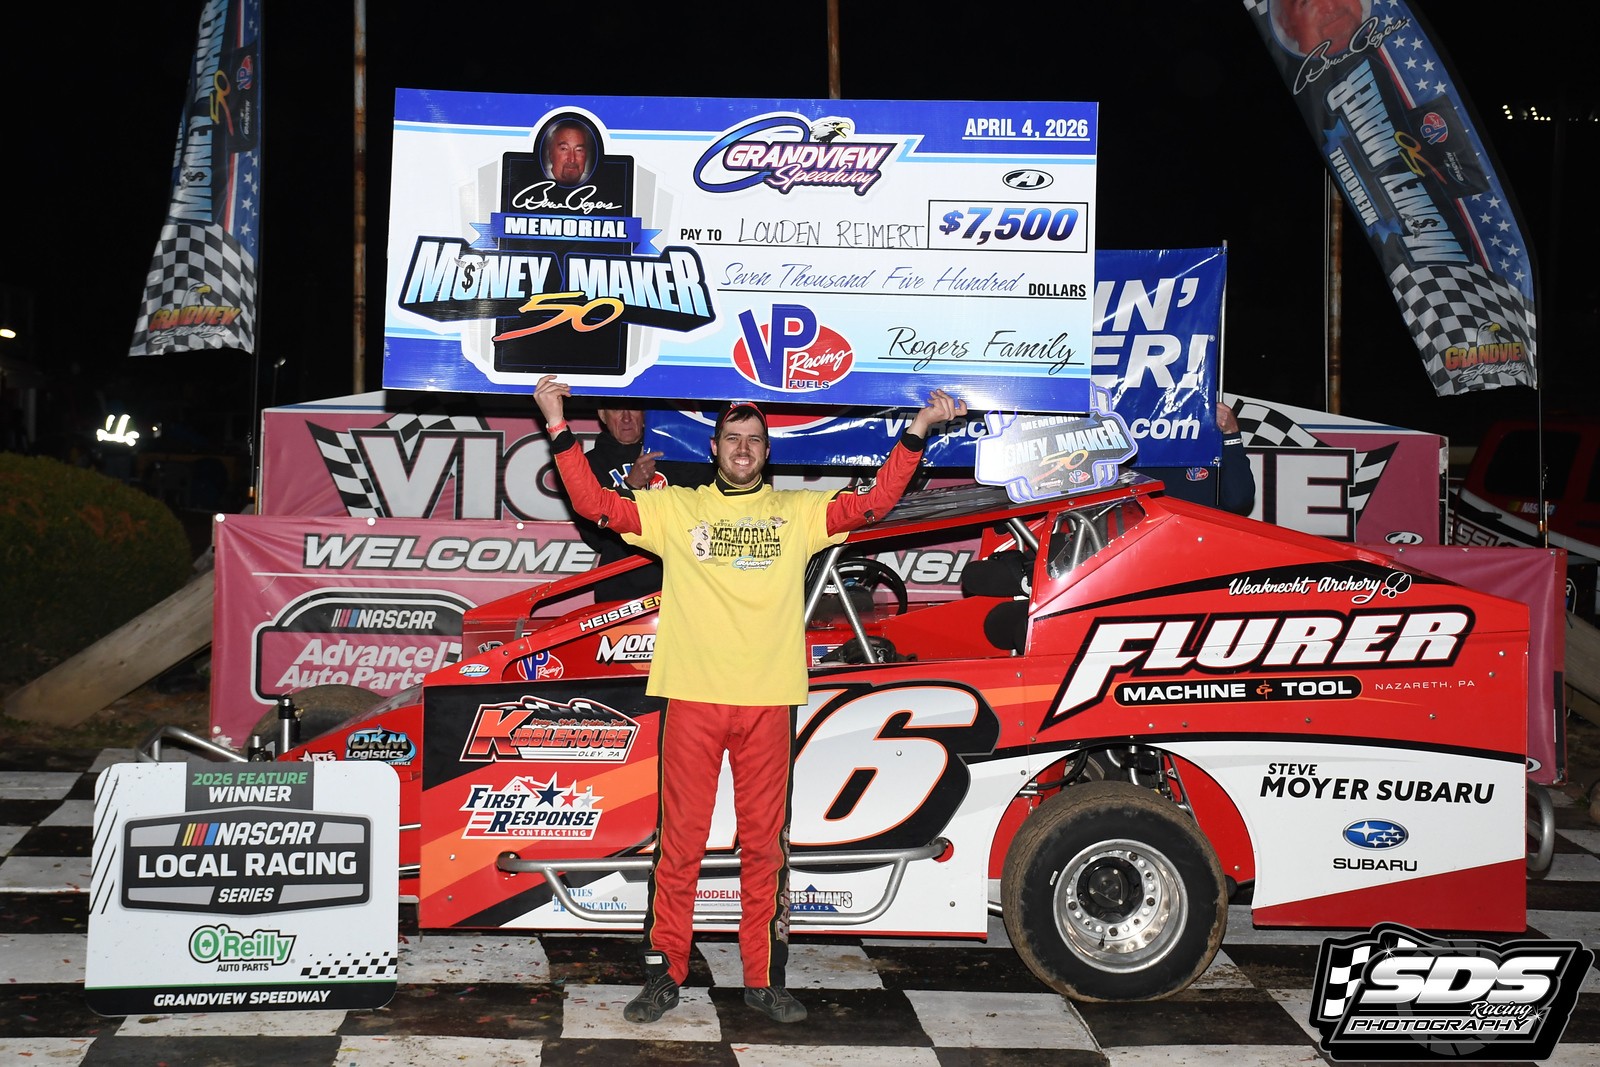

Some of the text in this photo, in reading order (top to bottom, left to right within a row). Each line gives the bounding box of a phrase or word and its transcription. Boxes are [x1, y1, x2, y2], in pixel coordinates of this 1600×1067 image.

[210, 69, 235, 136] 50
[1326, 58, 1402, 169] MAKER
[965, 118, 1089, 138] APRIL 4, 2026
[724, 143, 893, 170] GRANDVIEW
[1394, 131, 1448, 185] 50
[767, 164, 883, 194] Speedway
[1328, 146, 1379, 228] MEMORIAL
[504, 216, 628, 239] MEMORIAL
[939, 207, 1080, 246] $7,500
[1379, 171, 1470, 263] MONEY
[680, 228, 722, 241] PAY TO
[739, 218, 925, 249] LOUDEN REIMERT
[403, 241, 711, 319] MONEY MAKER
[721, 262, 1087, 298] Seven Thousand Five Hundred DOLLARS
[492, 290, 625, 342] 50
[738, 303, 818, 389] VP
[888, 326, 1077, 376] Rogers Family
[788, 347, 853, 378] Racing
[789, 379, 831, 391] FUELS
[1055, 419, 1129, 454] MAKER
[1032, 449, 1089, 483] 50
[711, 526, 780, 545] MEMORIAL
[305, 535, 599, 573] WELCOME
[708, 541, 782, 559] MONEY MAKER
[1228, 576, 1311, 597] Weaknecht
[356, 609, 438, 629] NASCAR
[293, 638, 442, 669] Advance
[596, 634, 657, 662] MOR
[276, 665, 427, 691] Auto Parts
[520, 650, 551, 680] VP
[538, 664, 563, 678] Racing
[1053, 612, 1469, 718] FLURER
[1123, 683, 1246, 701] MACHINE
[1281, 681, 1352, 697] TOOL
[1375, 679, 1476, 692] NAZARETH, PA
[351, 733, 409, 750] DKM
[469, 709, 630, 756] KIBBLEHOUSE
[346, 749, 404, 760] Logistics
[192, 771, 309, 786] 2026 FEATURE
[1268, 763, 1318, 777] STEVE
[208, 785, 293, 803] WINNER
[467, 787, 531, 809] FIRST
[1259, 776, 1496, 805] MOYER SUBARU
[214, 821, 317, 846] NASCAR
[487, 810, 599, 834] RESPONSE
[511, 828, 588, 838] CONTRACTING
[138, 851, 358, 878] LOCAL RACING
[1333, 857, 1417, 872] SUBARU
[218, 887, 275, 903] SERIES
[193, 928, 293, 963] O'Reilly
[217, 962, 269, 972] AUTO PARTS
[153, 990, 331, 1007] GRANDVIEW SPEEDWAY
